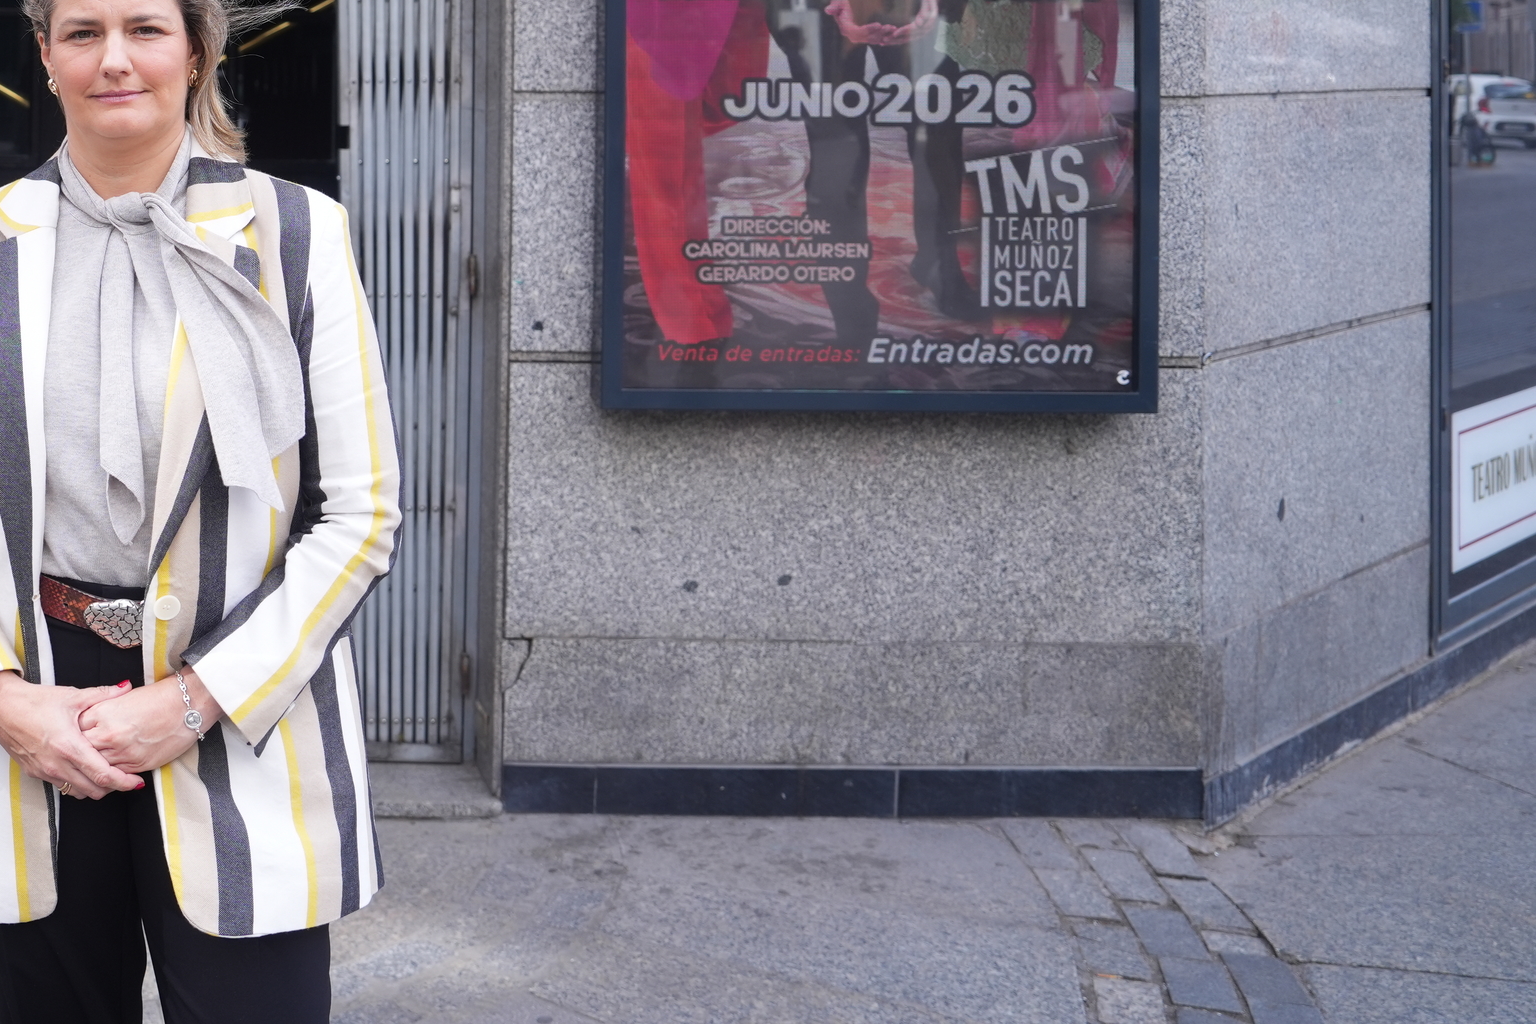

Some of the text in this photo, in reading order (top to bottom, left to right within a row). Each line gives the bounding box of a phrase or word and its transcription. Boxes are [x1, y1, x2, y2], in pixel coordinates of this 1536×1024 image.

[724, 74, 1033, 124] JUNIO 2026
[965, 145, 1090, 213] TMS
[724, 215, 831, 234] DIRECCIÓN:
[995, 217, 1074, 241] TEATRO
[685, 242, 868, 258] CAROLINA LAURSEN
[994, 240, 1073, 269] MUÑOZ
[699, 266, 855, 282] GERARDO OTERO
[994, 270, 1072, 307] SECA
[658, 337, 1093, 364] Venta de entradas: Entradas.com
[1471, 452, 1510, 502] TEATRO
